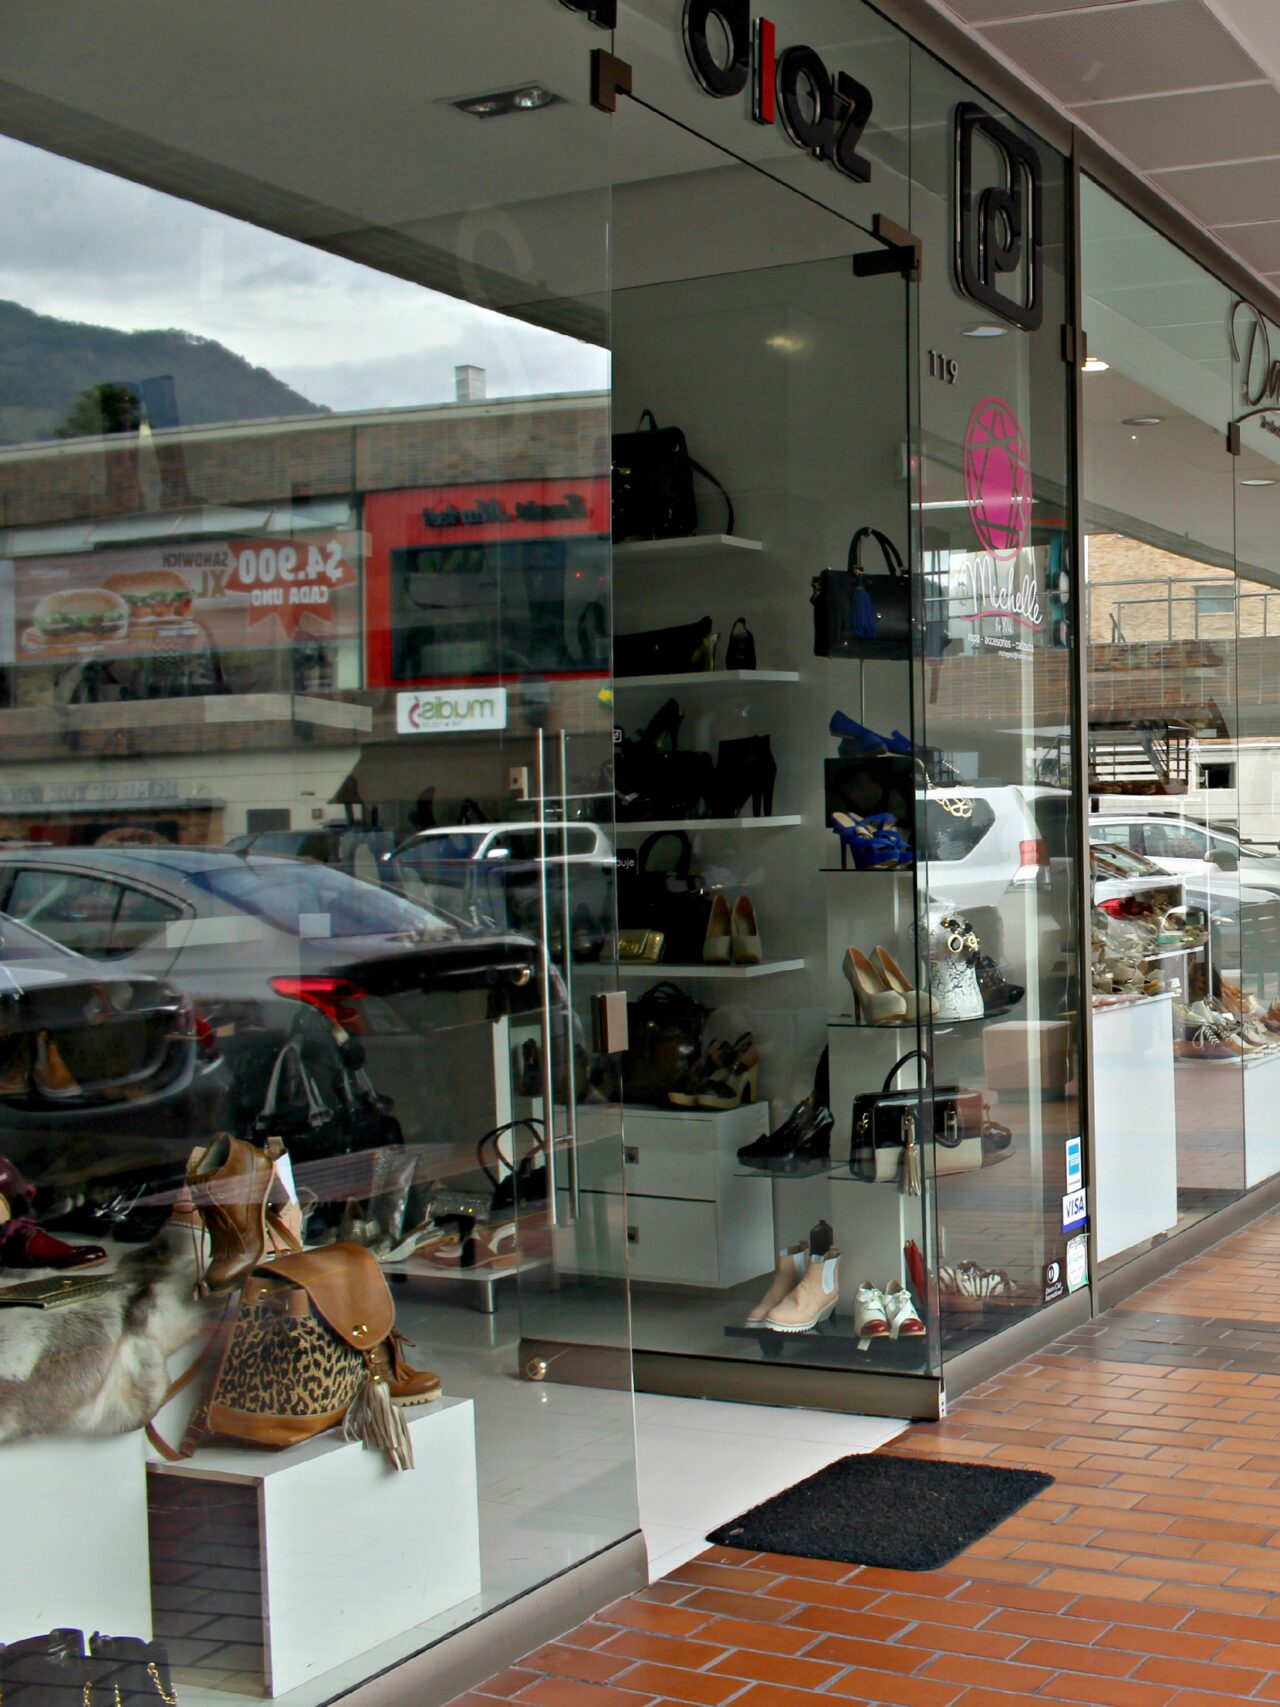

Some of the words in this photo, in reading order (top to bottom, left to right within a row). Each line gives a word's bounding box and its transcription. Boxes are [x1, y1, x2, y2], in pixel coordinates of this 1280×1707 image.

[929, 349, 959, 385] 119
[962, 549, 1043, 625] Michelle
[1066, 1196, 1084, 1218] VISA
